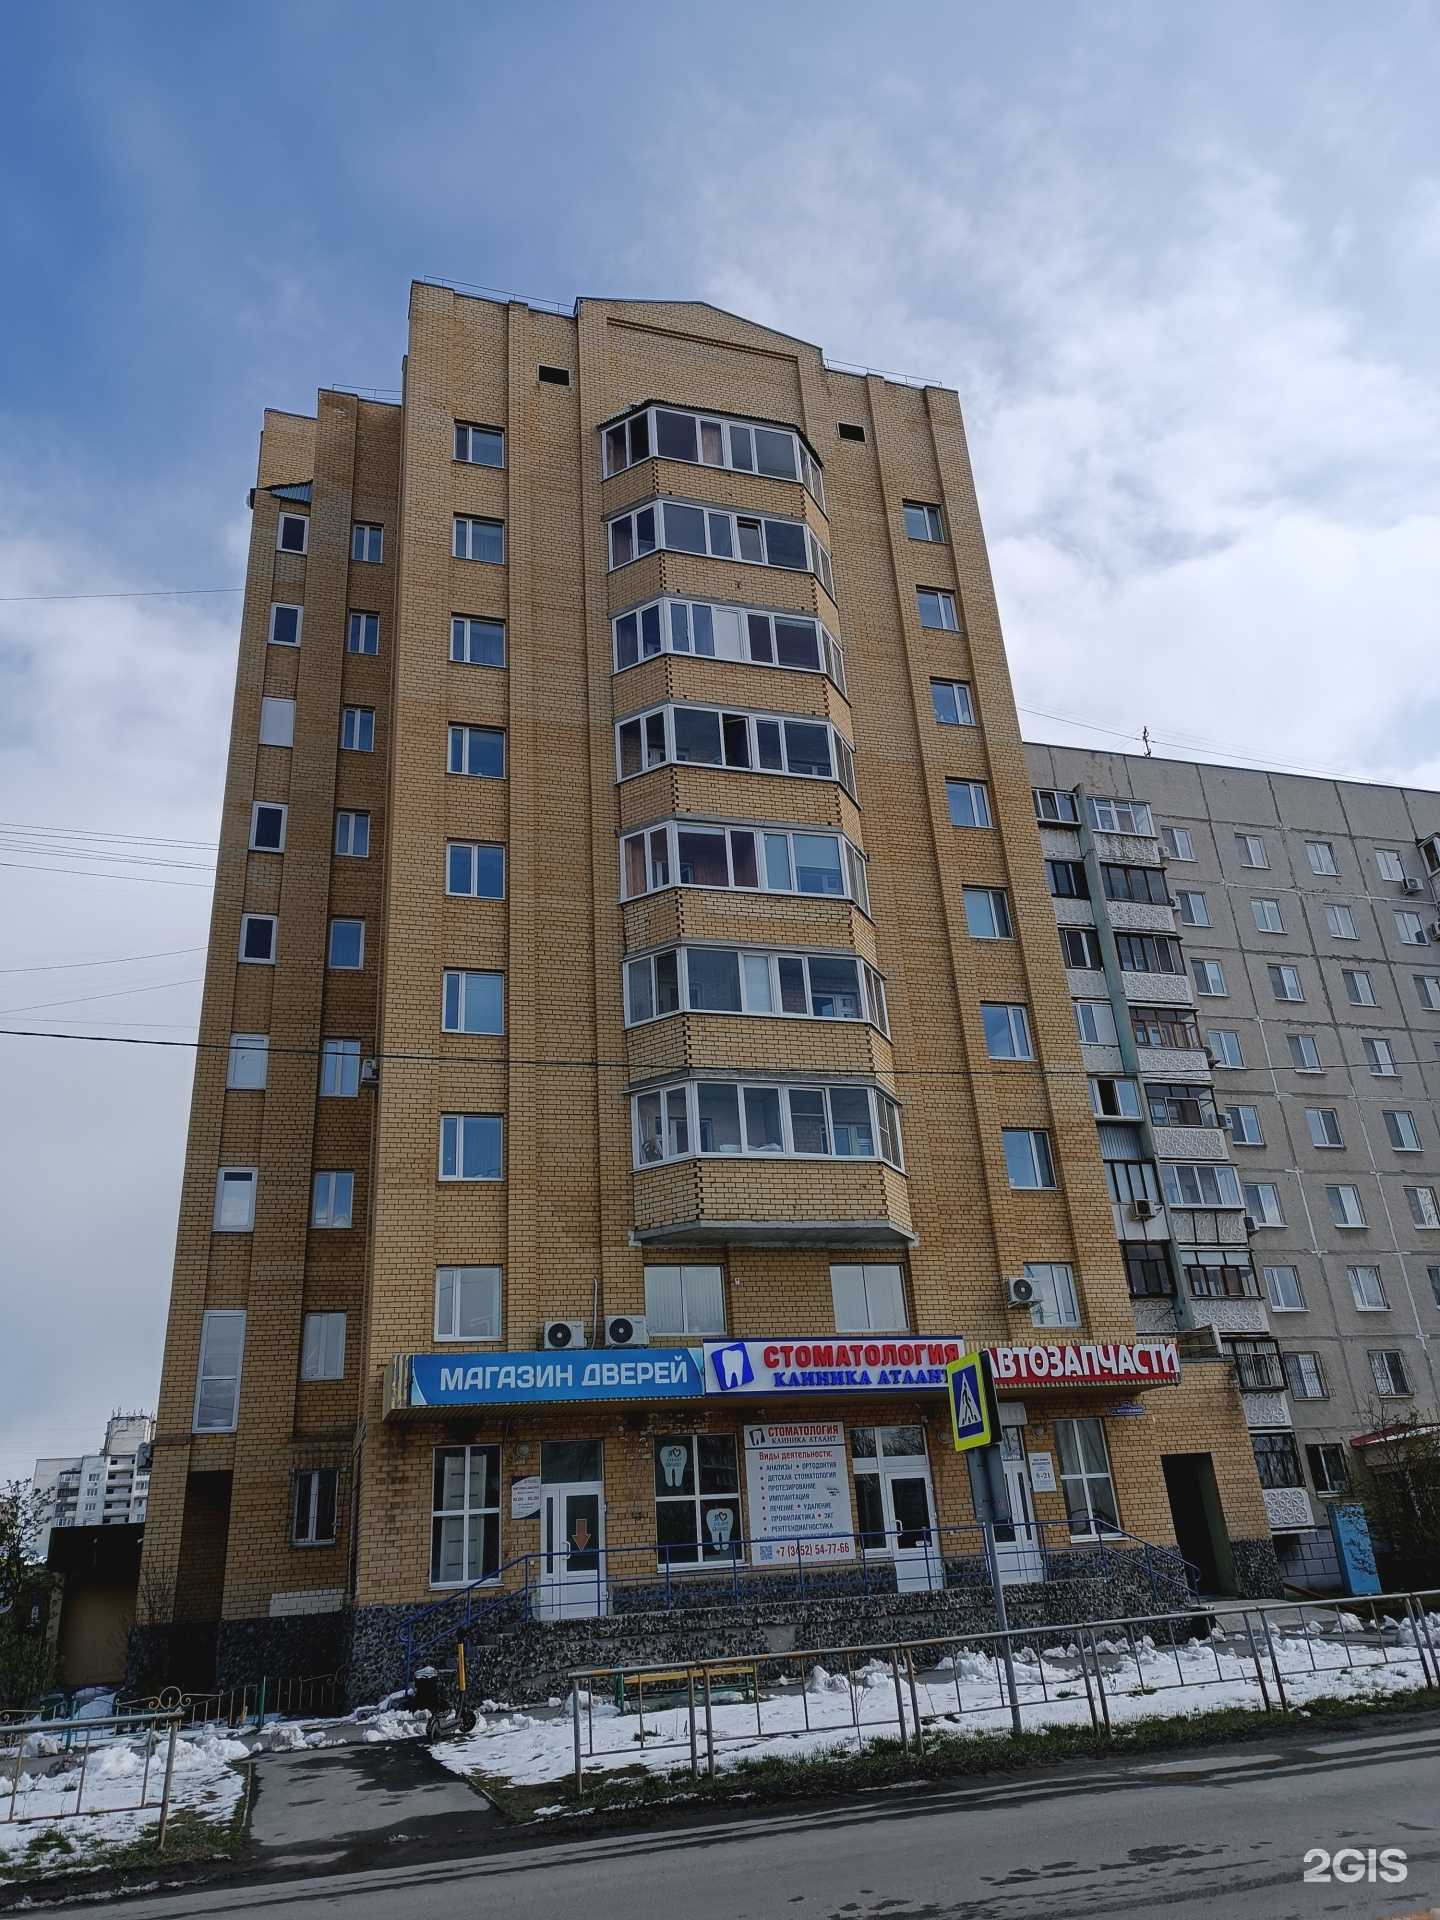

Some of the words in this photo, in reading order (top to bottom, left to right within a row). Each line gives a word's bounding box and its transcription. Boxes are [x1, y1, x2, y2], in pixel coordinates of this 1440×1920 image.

[763, 1343, 959, 1369] СТОМАТОЛОГИЯ
[440, 1364, 573, 1391] МАГАЗИН
[581, 1355, 688, 1386] ДВЕРЕЙ
[774, 1371, 872, 1388] КЛИНИКА
[768, 1424, 839, 1437] СТОМАТОЛОГИЯ
[771, 1437, 806, 1445] КЛИНИКА
[809, 1435, 837, 1443] АТЛАНТ
[759, 1451, 780, 1461] Виды
[782, 1450, 833, 1461] деятельности:
[766, 1463, 793, 1471] АНАЛИЗЫ
[767, 1474, 792, 1482] ДЕТСКАЯ
[794, 1472, 837, 1481] СТОМАТОЛОГИЯ
[767, 1483, 816, 1492] ПРОТЕЗИРОВАНИЕ
[768, 1493, 810, 1502] ИМПЛАНТАЦИЯ
[803, 1502, 832, 1511] УДАЛЕНИЕ
[770, 1514, 816, 1523] ПРОФИЛАКТИКА
[775, 1546, 785, 1557] +7
[815, 1542, 850, 1556] 54-77-66
